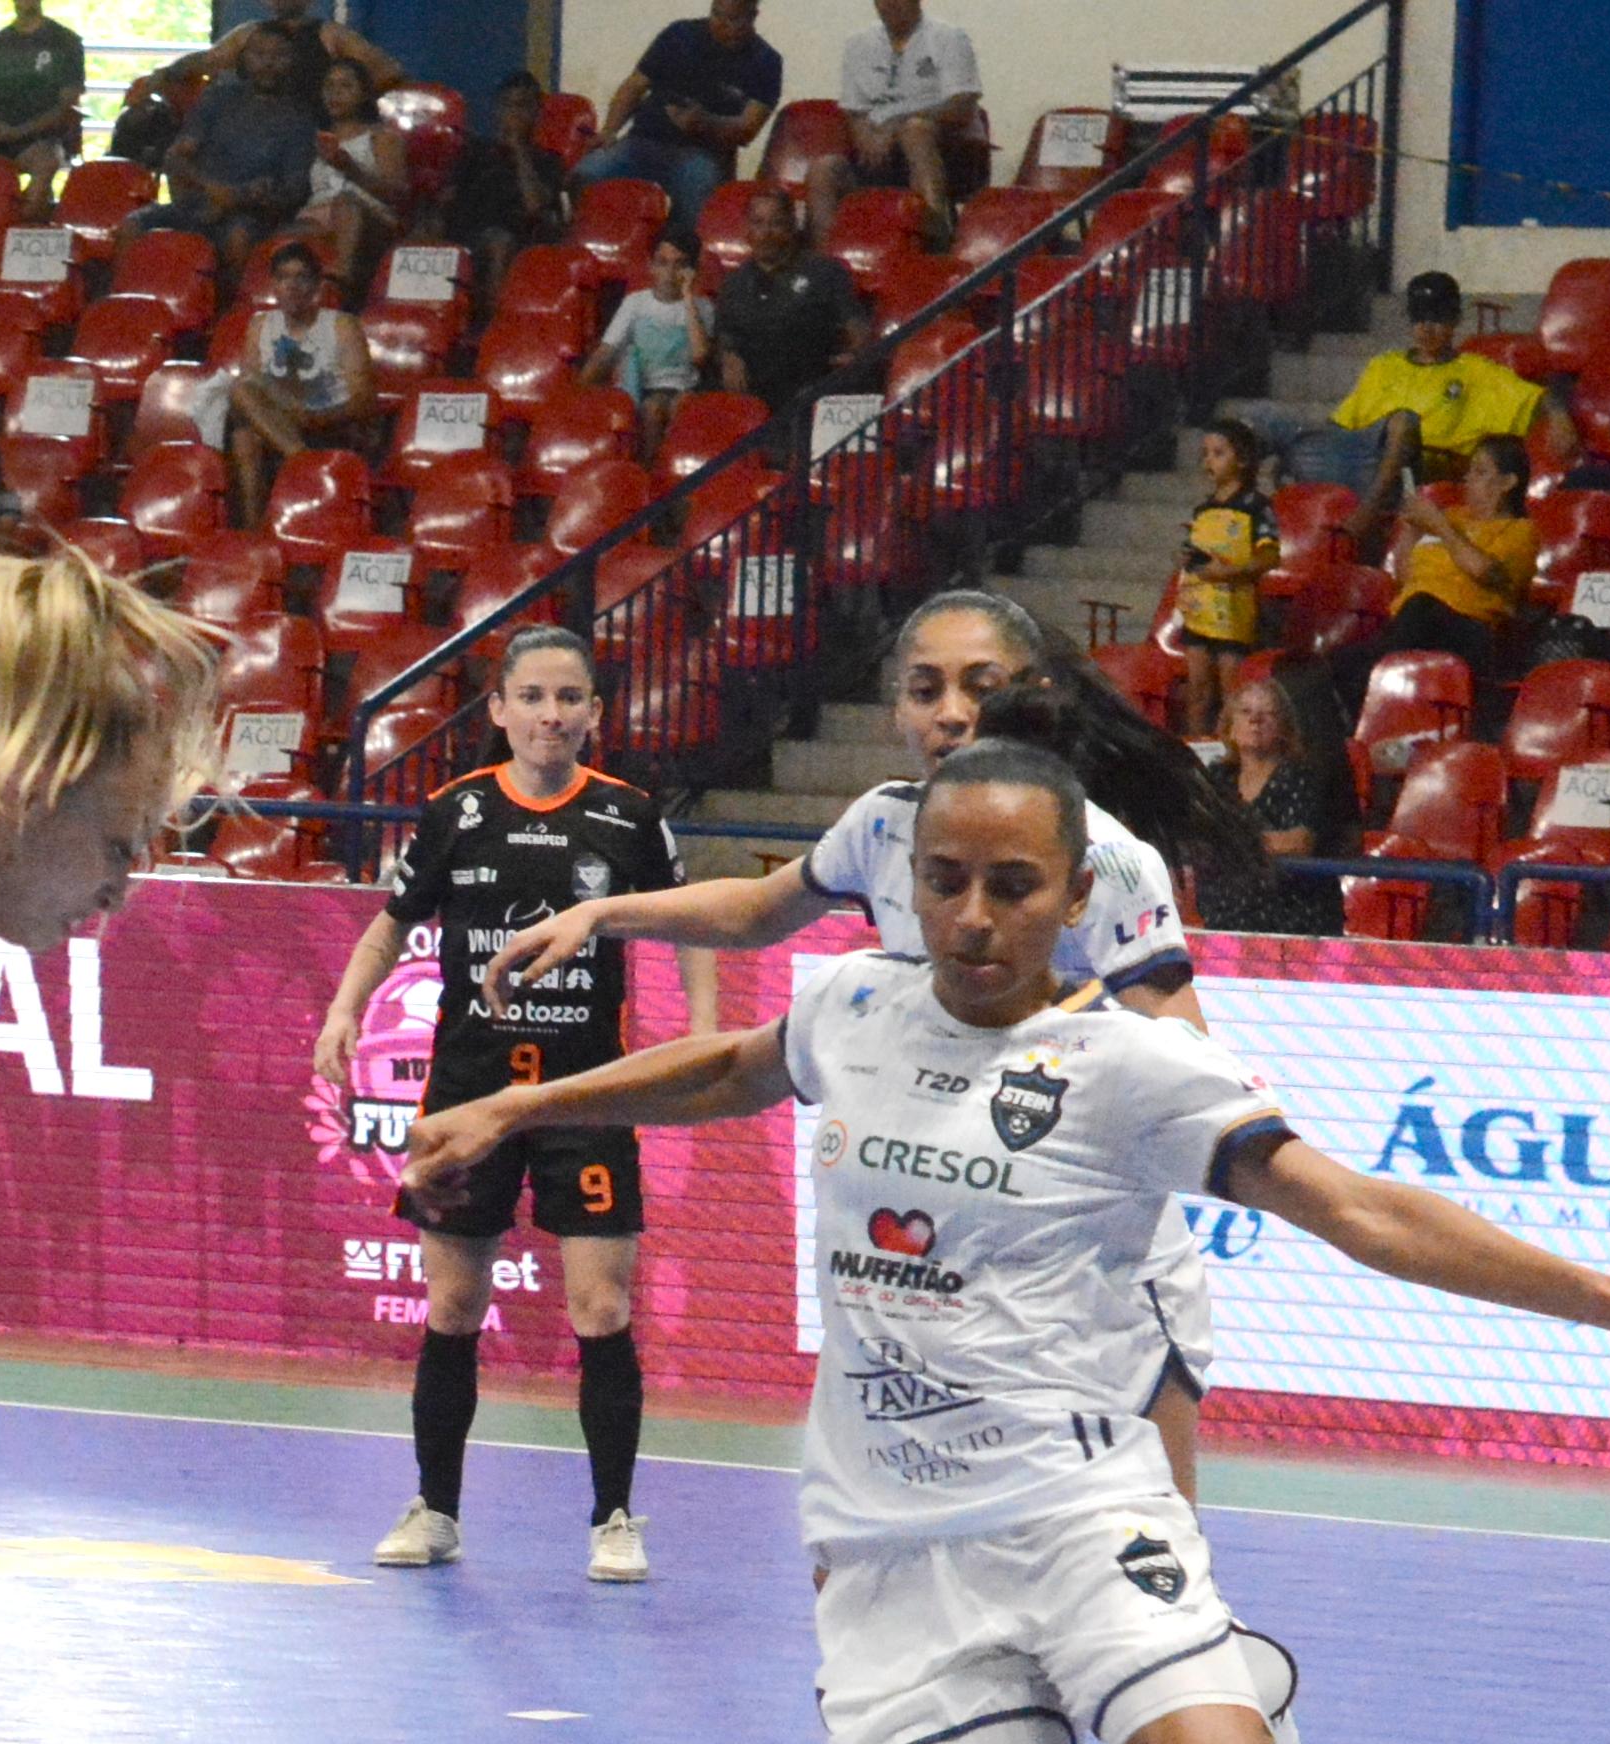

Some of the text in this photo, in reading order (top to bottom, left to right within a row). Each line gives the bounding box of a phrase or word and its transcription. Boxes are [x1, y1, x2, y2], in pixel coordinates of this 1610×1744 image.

[425, 405, 483, 424] AQUI
[238, 725, 298, 746] AQUI
[1114, 904, 1170, 946] LFF
[526, 1000, 590, 1023] tozzo
[510, 1043, 544, 1085] 9
[913, 1067, 971, 1094] T2D
[998, 1087, 1056, 1114] STEIN
[858, 1135, 1023, 1197] CRESOL
[580, 1164, 615, 1214] 9
[830, 1251, 965, 1294] MUFFATÃO
[1071, 1411, 1115, 1462] 11
